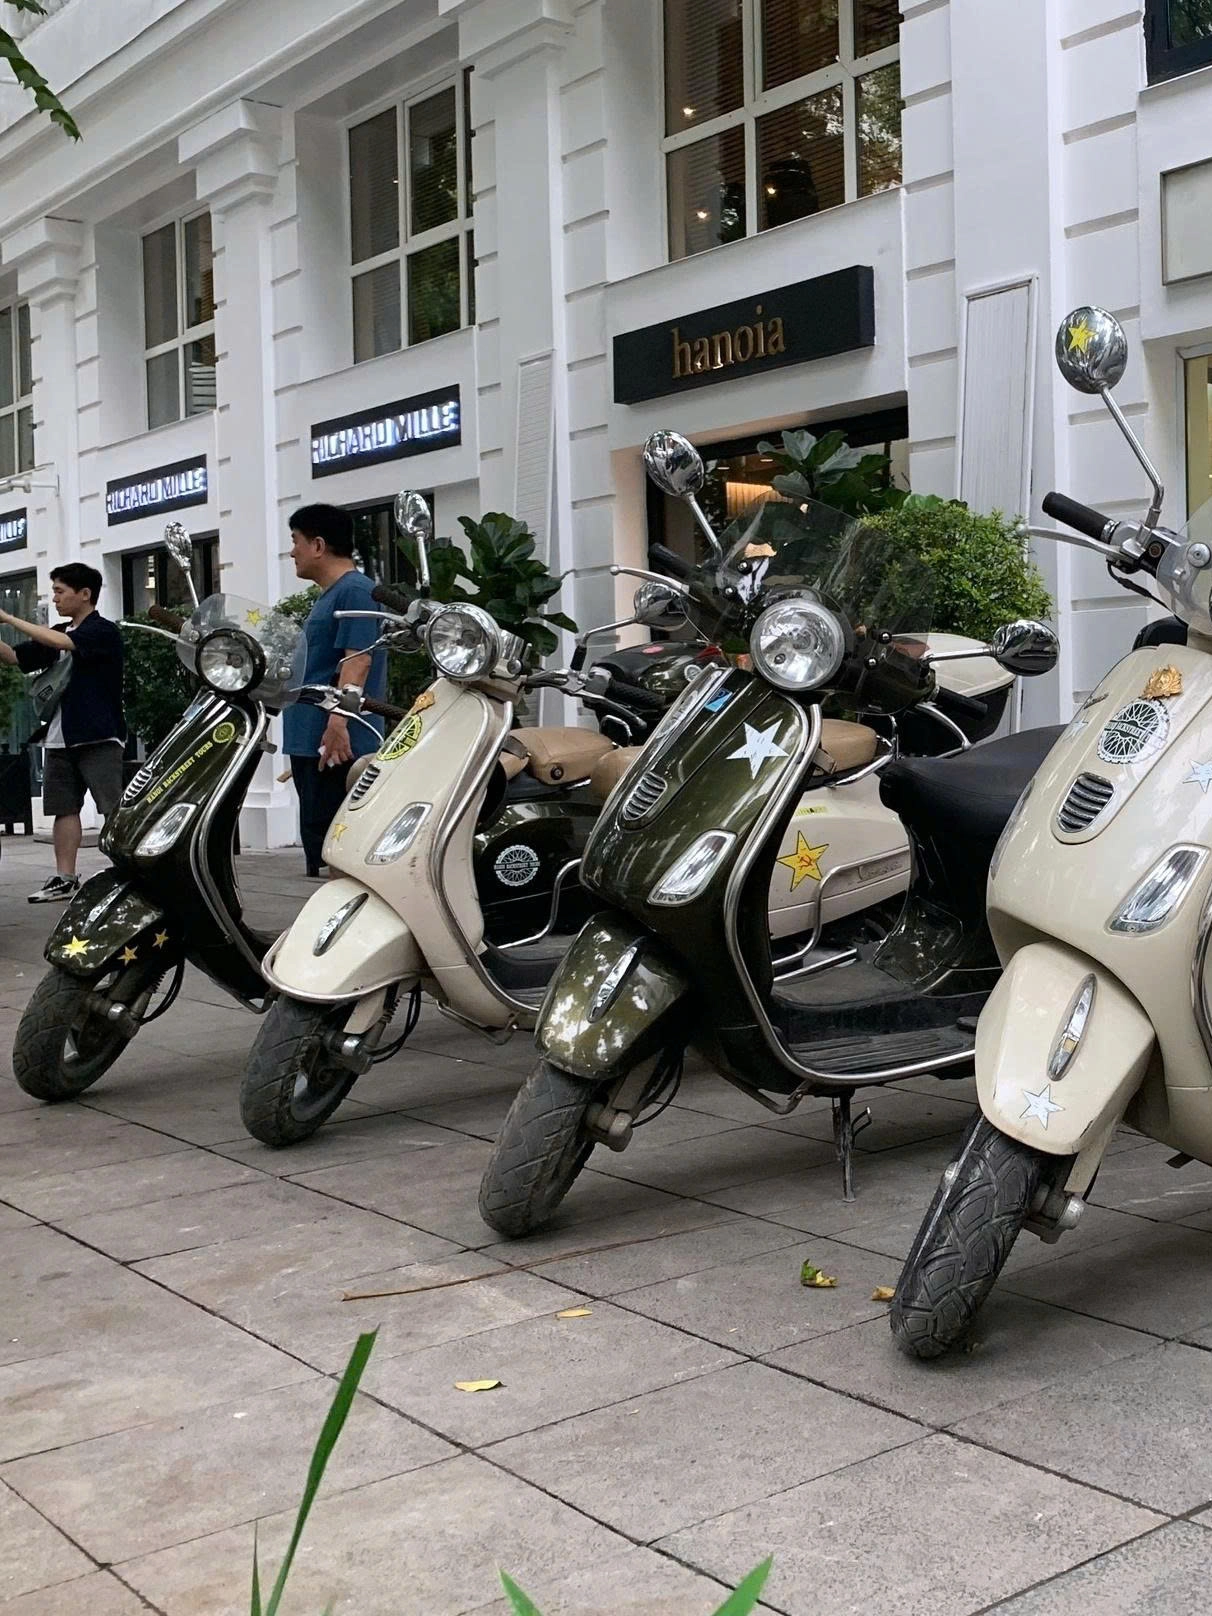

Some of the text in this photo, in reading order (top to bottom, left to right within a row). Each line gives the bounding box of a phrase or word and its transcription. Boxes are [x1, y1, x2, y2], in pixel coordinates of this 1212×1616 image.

[671, 305, 786, 379] hanoia
[311, 400, 458, 464] RICHARD MILLE
[106, 467, 207, 514] RICHARD MILLE
